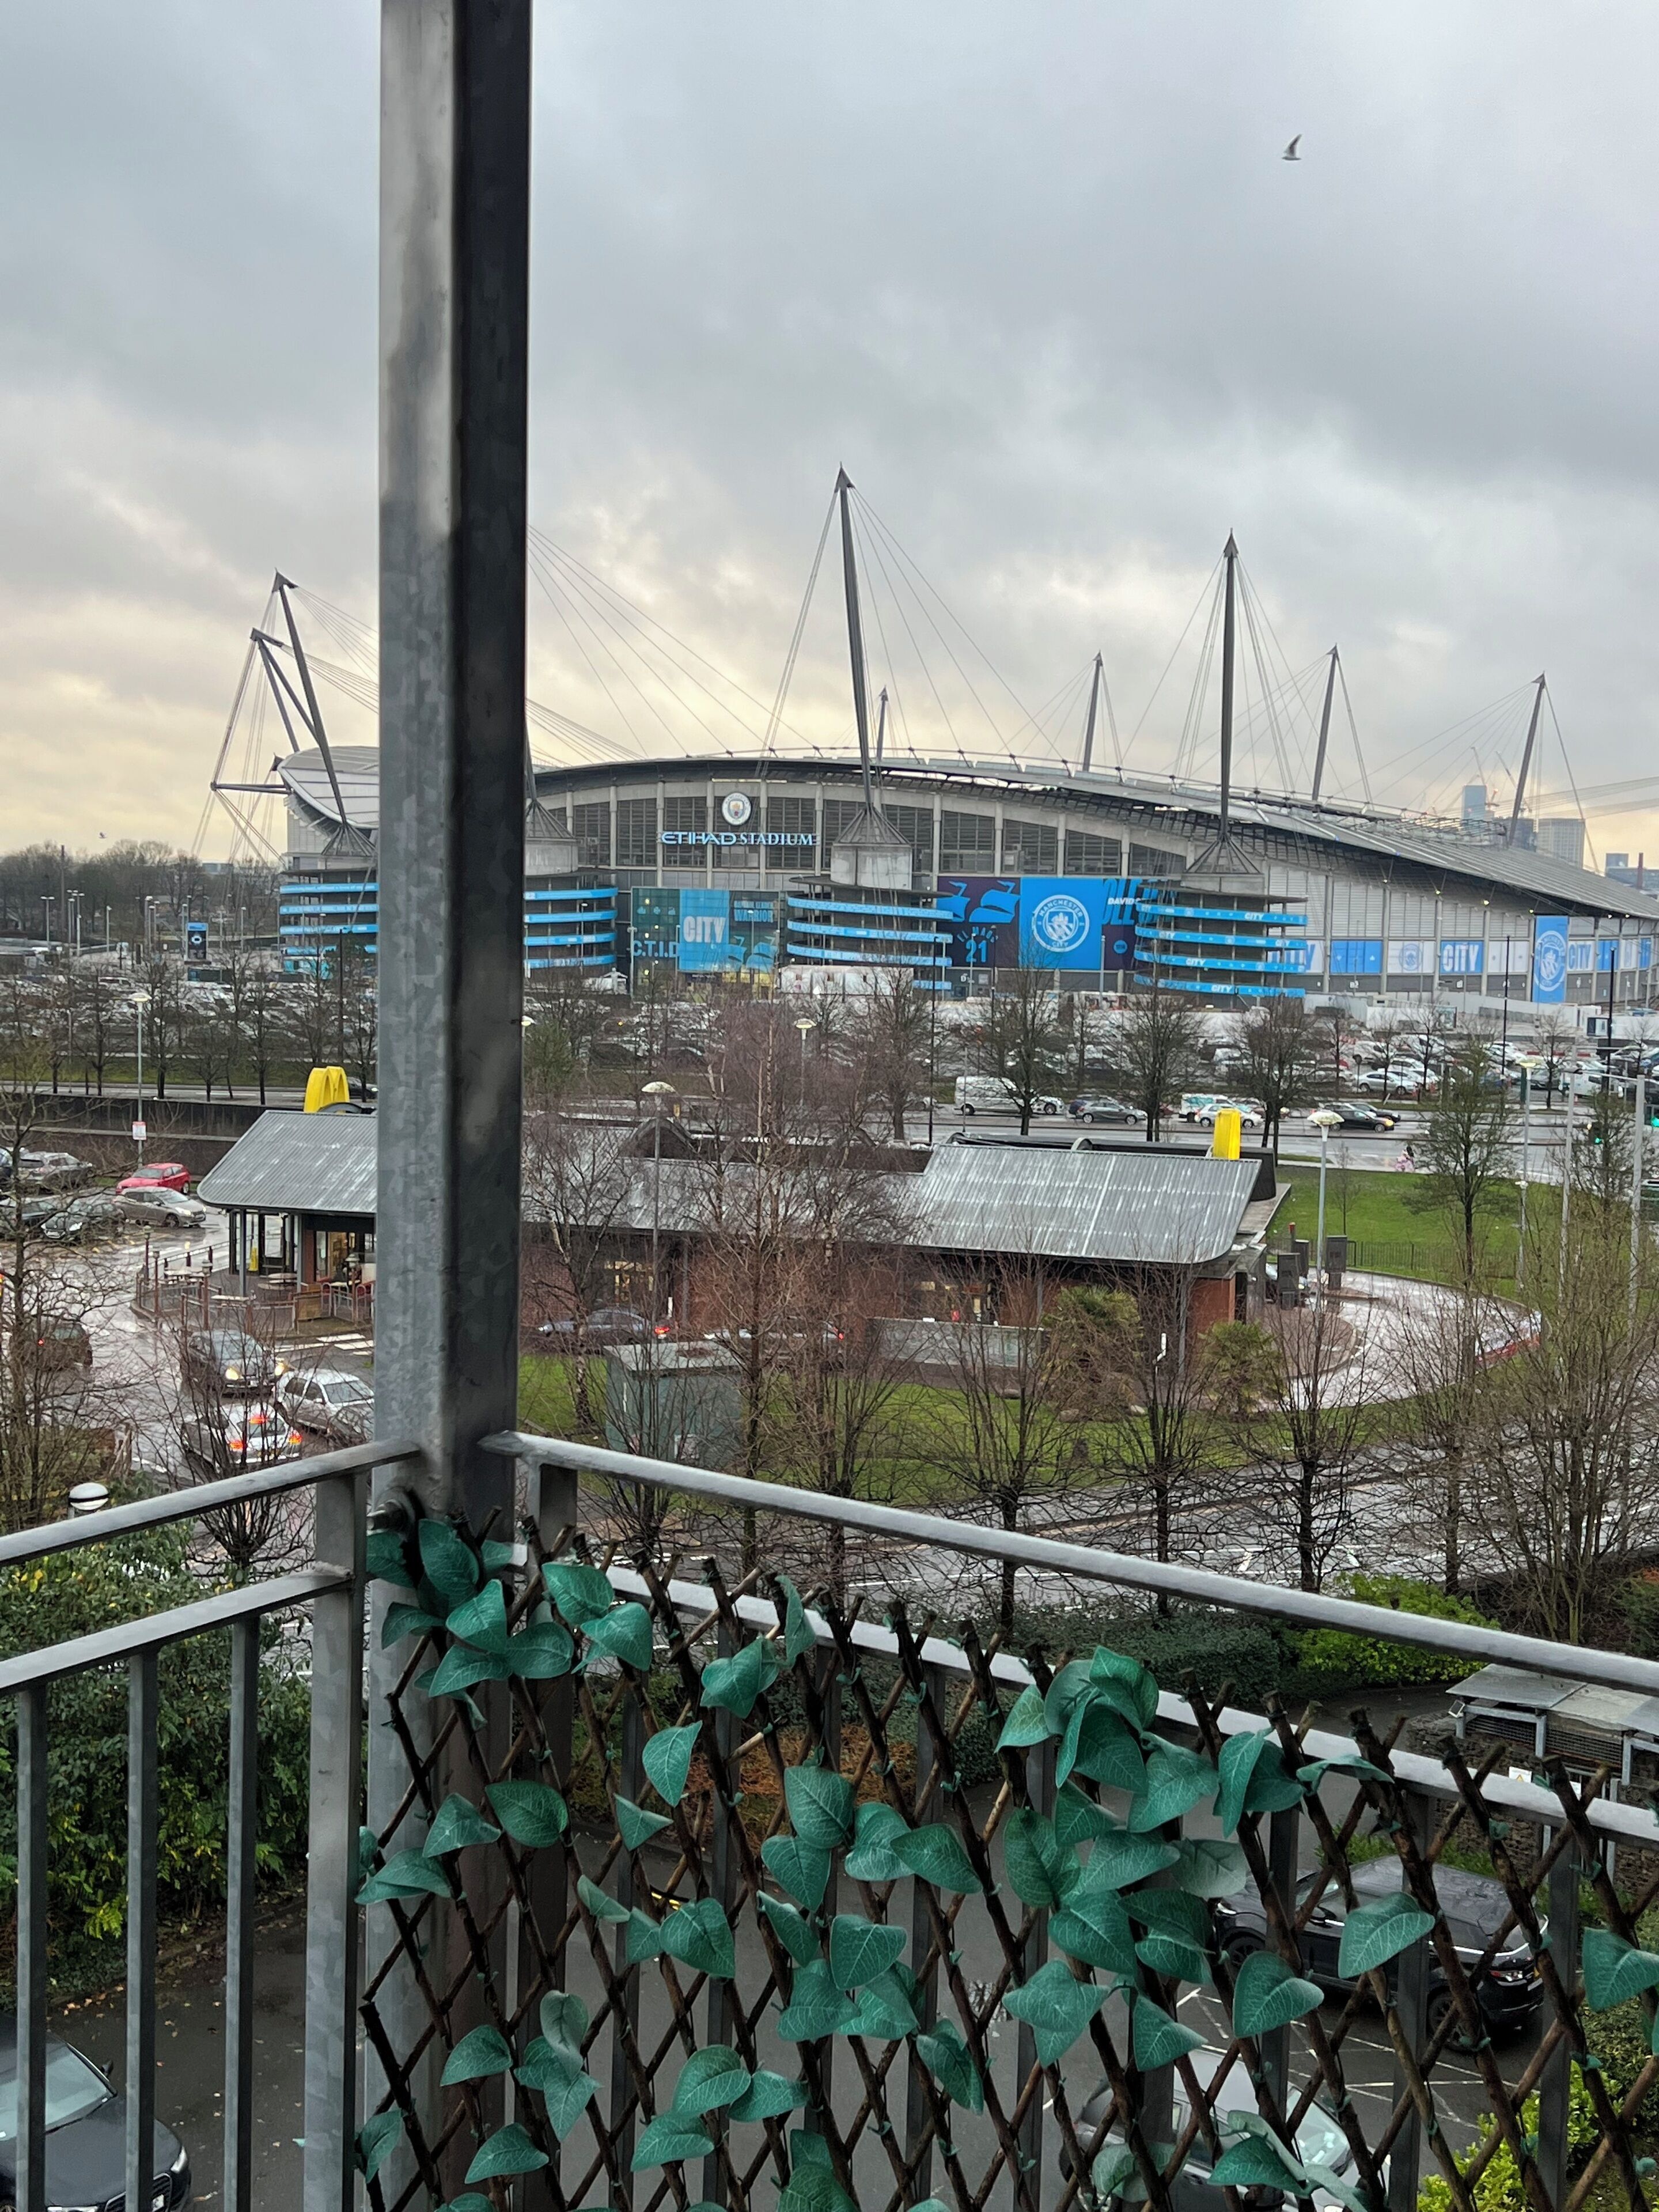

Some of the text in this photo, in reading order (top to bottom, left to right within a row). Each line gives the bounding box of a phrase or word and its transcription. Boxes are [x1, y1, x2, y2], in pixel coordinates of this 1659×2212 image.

[662, 832, 813, 846] ETIHAD STADIUM
[734, 909, 773, 923] WARRIOR
[1039, 900, 1083, 917] MANCHESTER
[1245, 912, 1265, 921] CITY
[684, 916, 726, 943] CITY
[965, 940, 987, 963] 21
[1442, 944, 1480, 972] CITY
[1568, 944, 1592, 969] CITY
[1185, 957, 1206, 967] CITY
[1211, 984, 1232, 993] CITY
